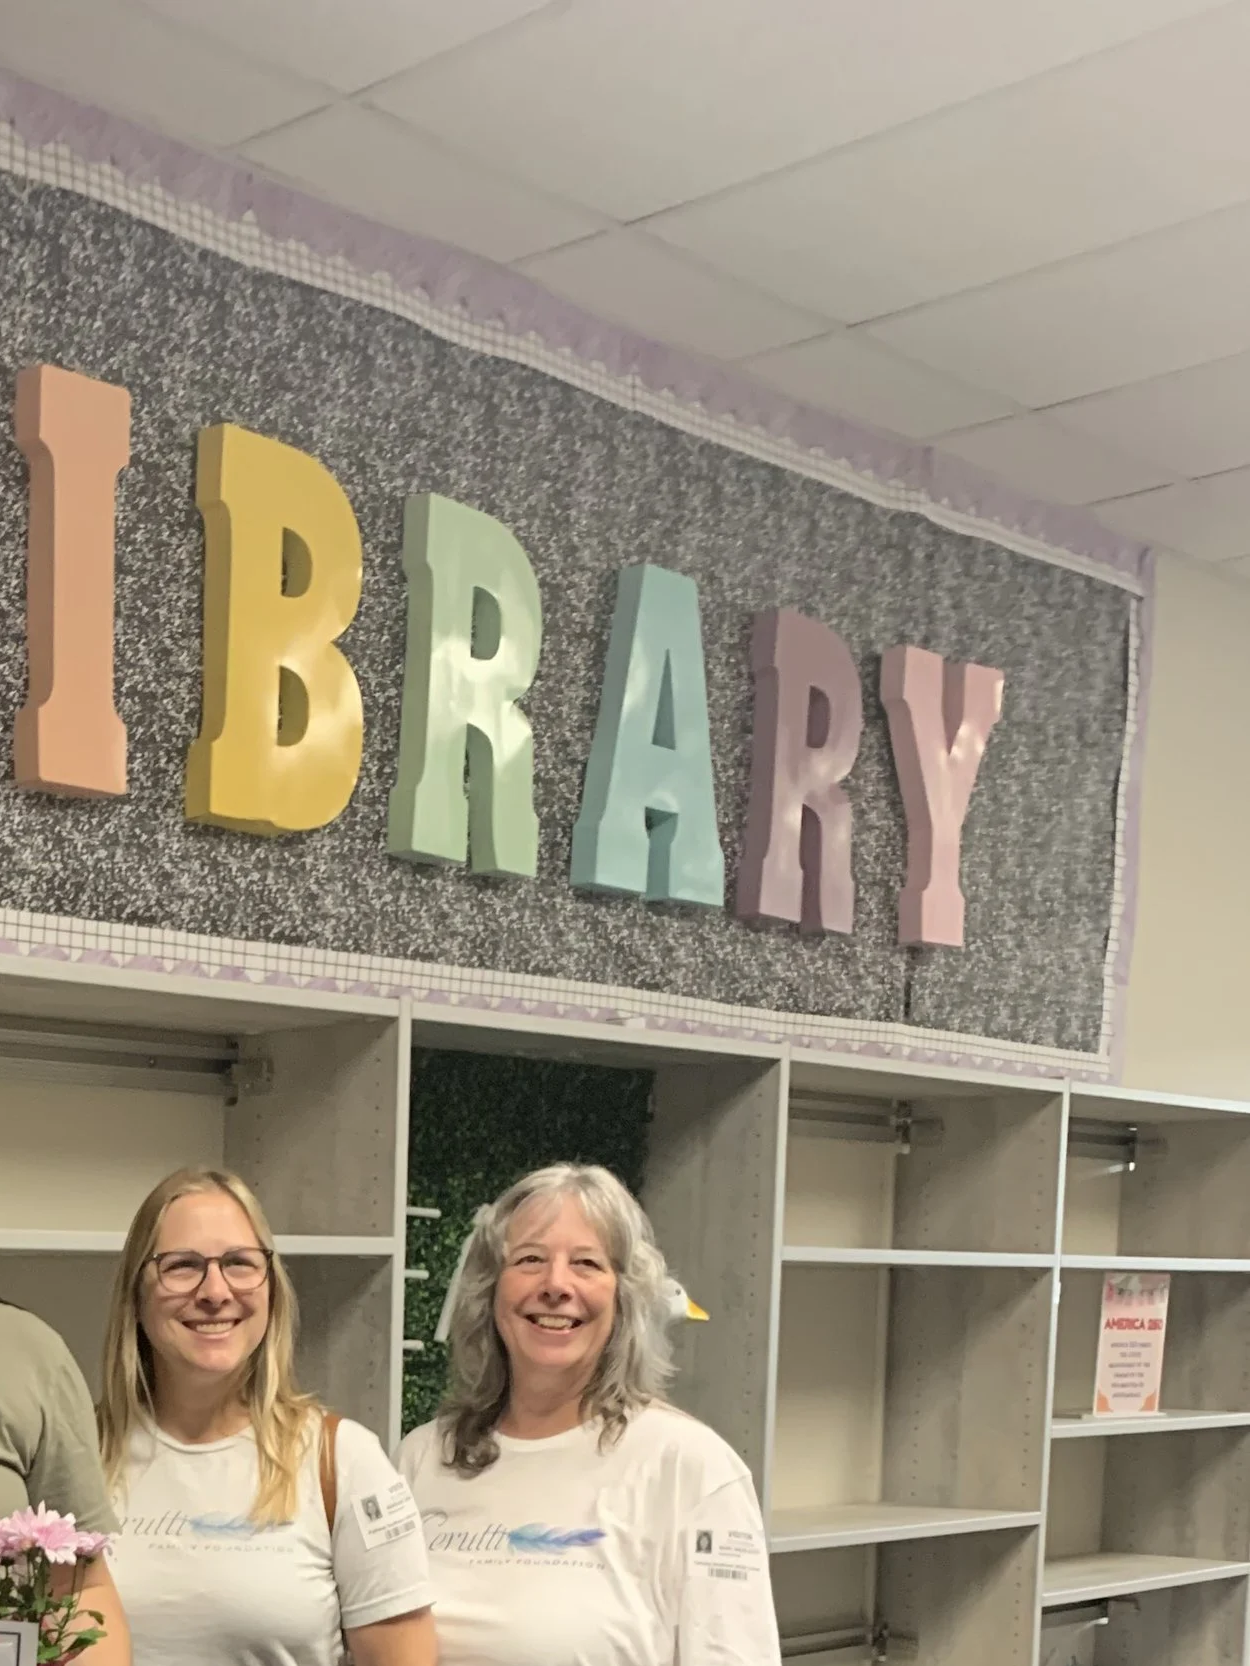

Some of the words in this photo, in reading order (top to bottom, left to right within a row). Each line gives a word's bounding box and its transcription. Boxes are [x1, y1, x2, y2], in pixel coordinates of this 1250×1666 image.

[1104, 1317, 1144, 1330] AMERICA
[148, 1543, 198, 1551] FAMIY
[469, 1559, 510, 1568] FAMILY
[516, 1559, 606, 1570] FOUNDATION
